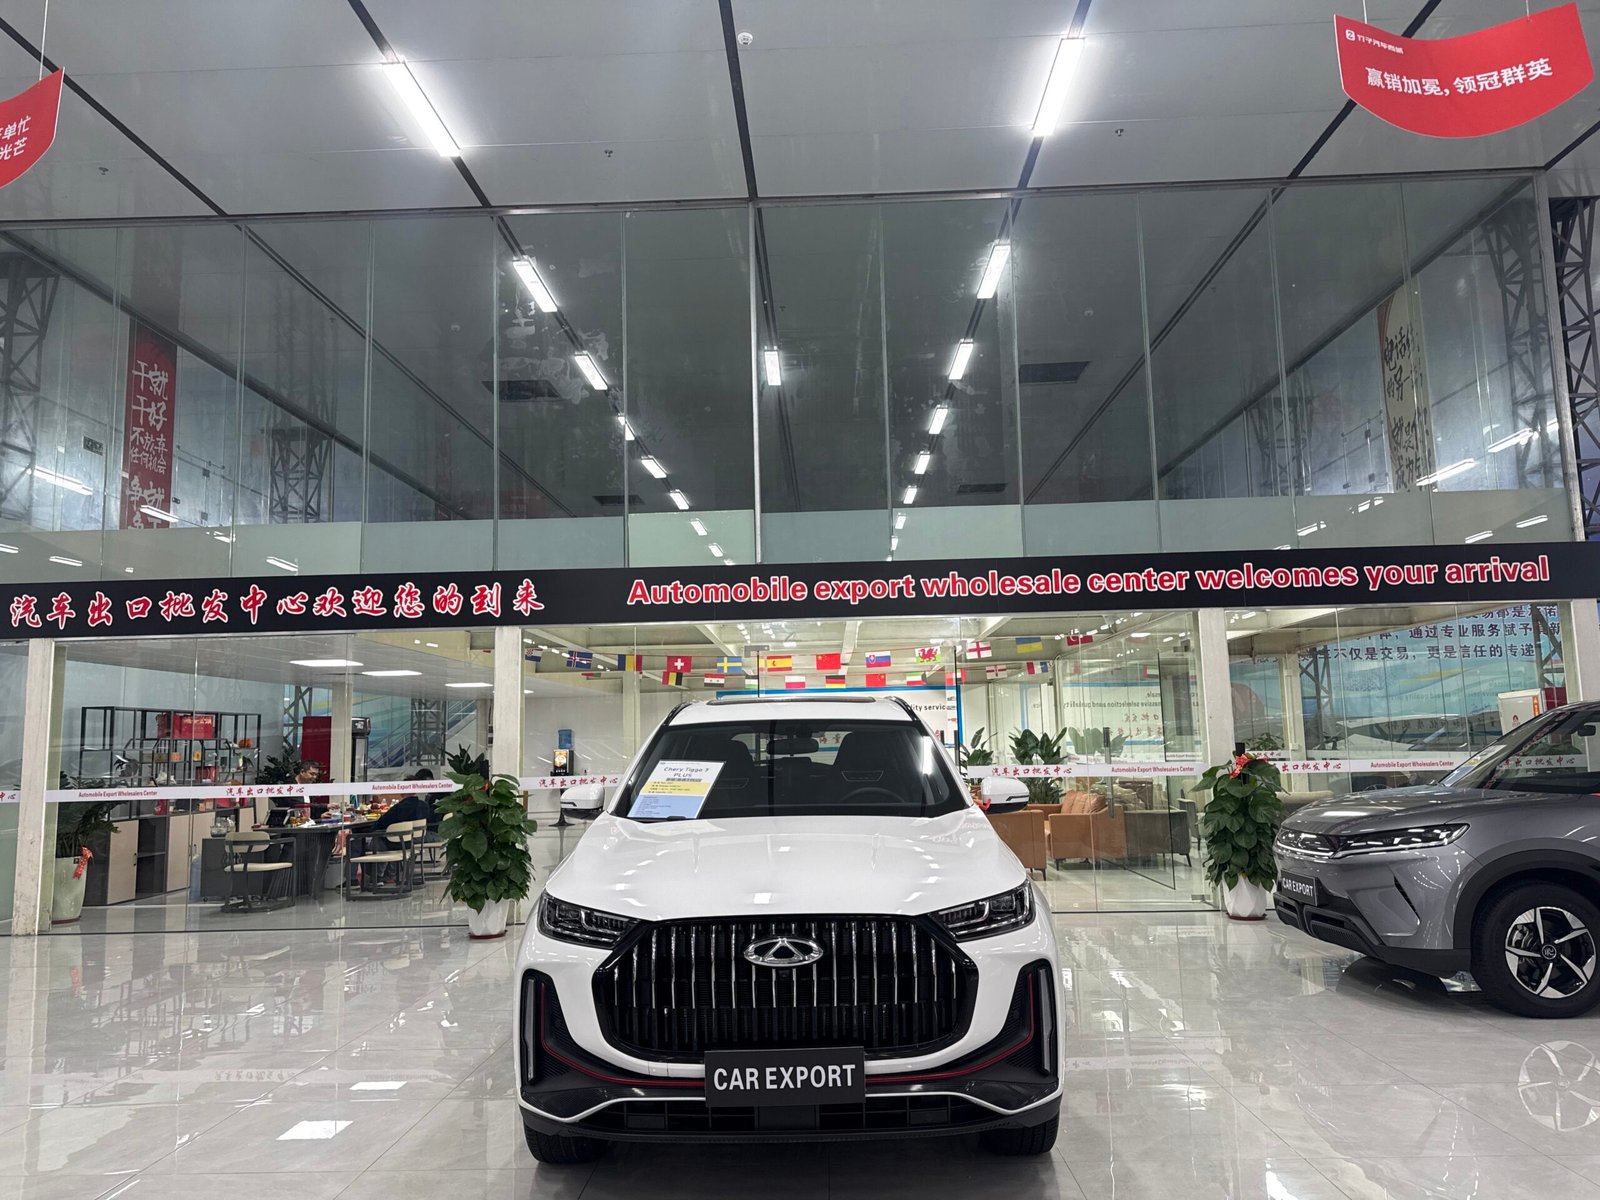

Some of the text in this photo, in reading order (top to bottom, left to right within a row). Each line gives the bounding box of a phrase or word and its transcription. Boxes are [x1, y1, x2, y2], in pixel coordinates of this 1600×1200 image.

[627, 555, 1550, 605] Automobile export wholesale center welcomes your arrival
[10, 578, 545, 630] 汽车出口批发中心欢迎您的到来
[991, 766, 1073, 777] 汽车出口批发中心
[103, 790, 117, 798] Export
[226, 786, 305, 797] 汽车出口批发中心
[1282, 877, 1314, 897] CAR EXPORT
[713, 1064, 856, 1091] CAR EXPORT
